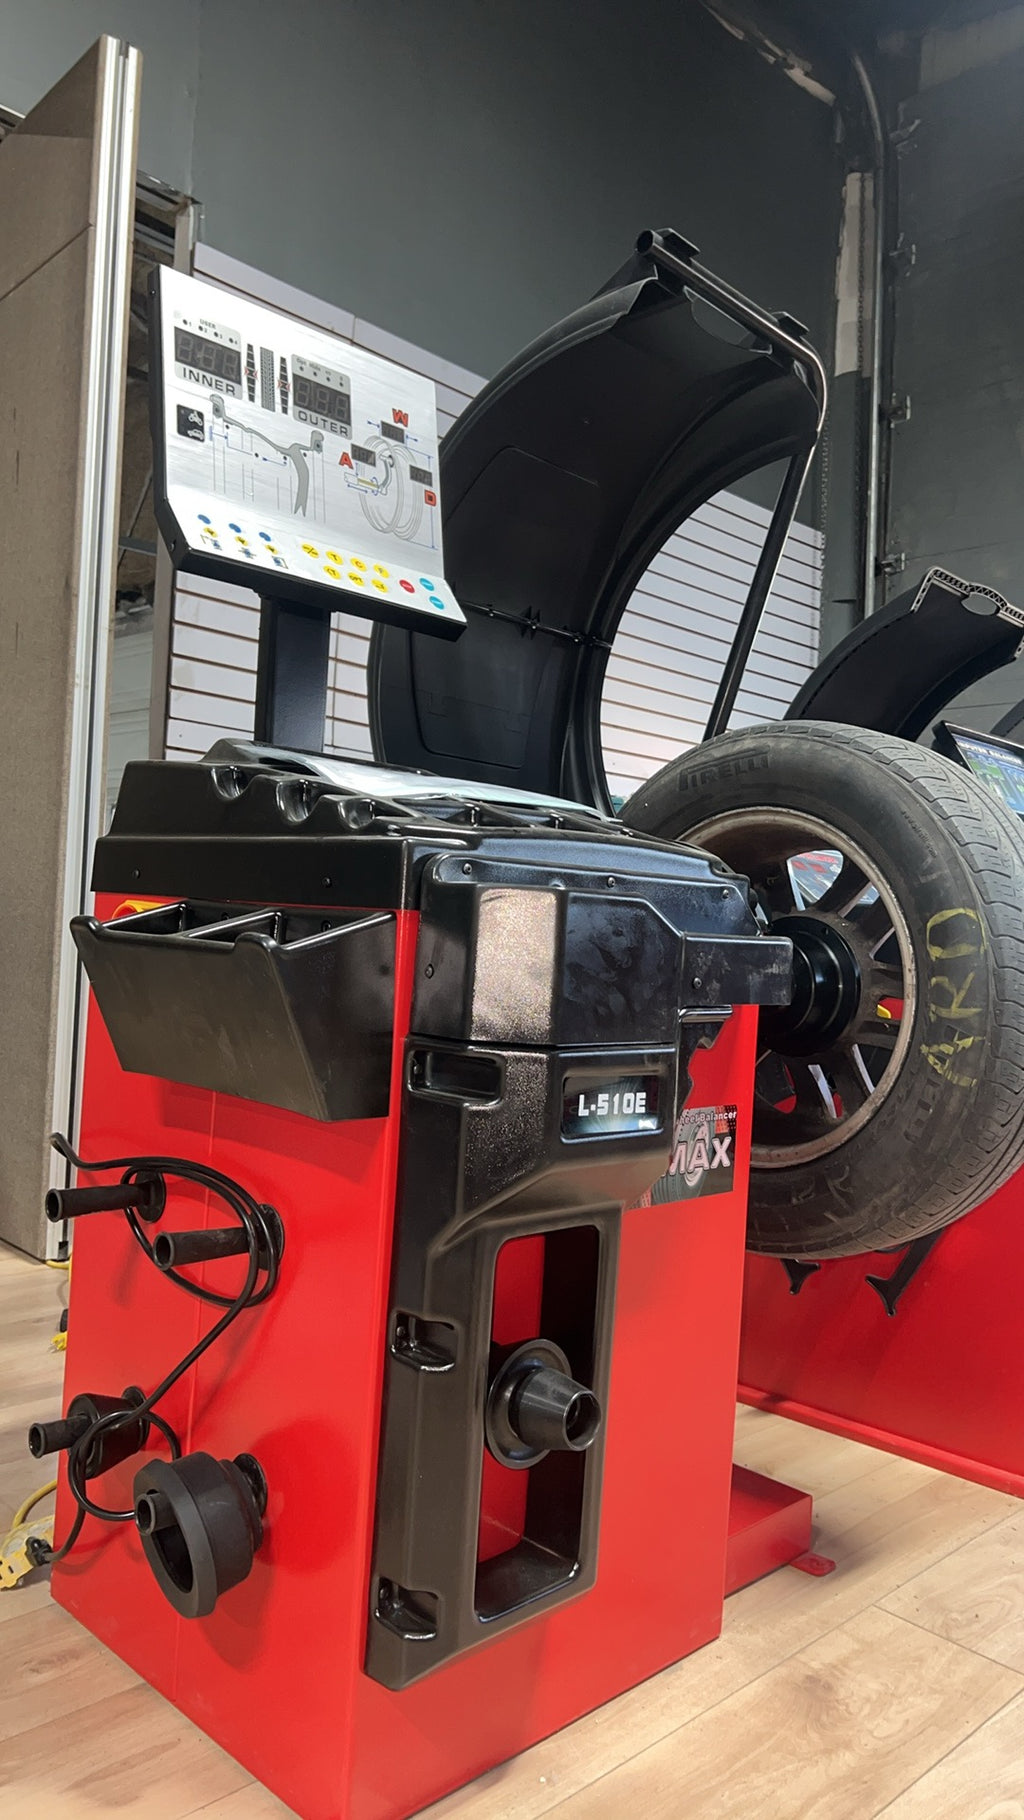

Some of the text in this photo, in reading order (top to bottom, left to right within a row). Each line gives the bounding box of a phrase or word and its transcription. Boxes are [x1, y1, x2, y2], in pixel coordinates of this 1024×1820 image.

[199, 318, 217, 330] USER
[182, 366, 236, 396] INNER
[298, 410, 348, 437] OUTER
[392, 408, 409, 427] W
[338, 451, 354, 470] A
[424, 489, 437, 507] D
[677, 744, 769, 791] PIRELLI
[577, 1091, 647, 1117] L-510E
[700, 1111, 738, 1122] Balancer
